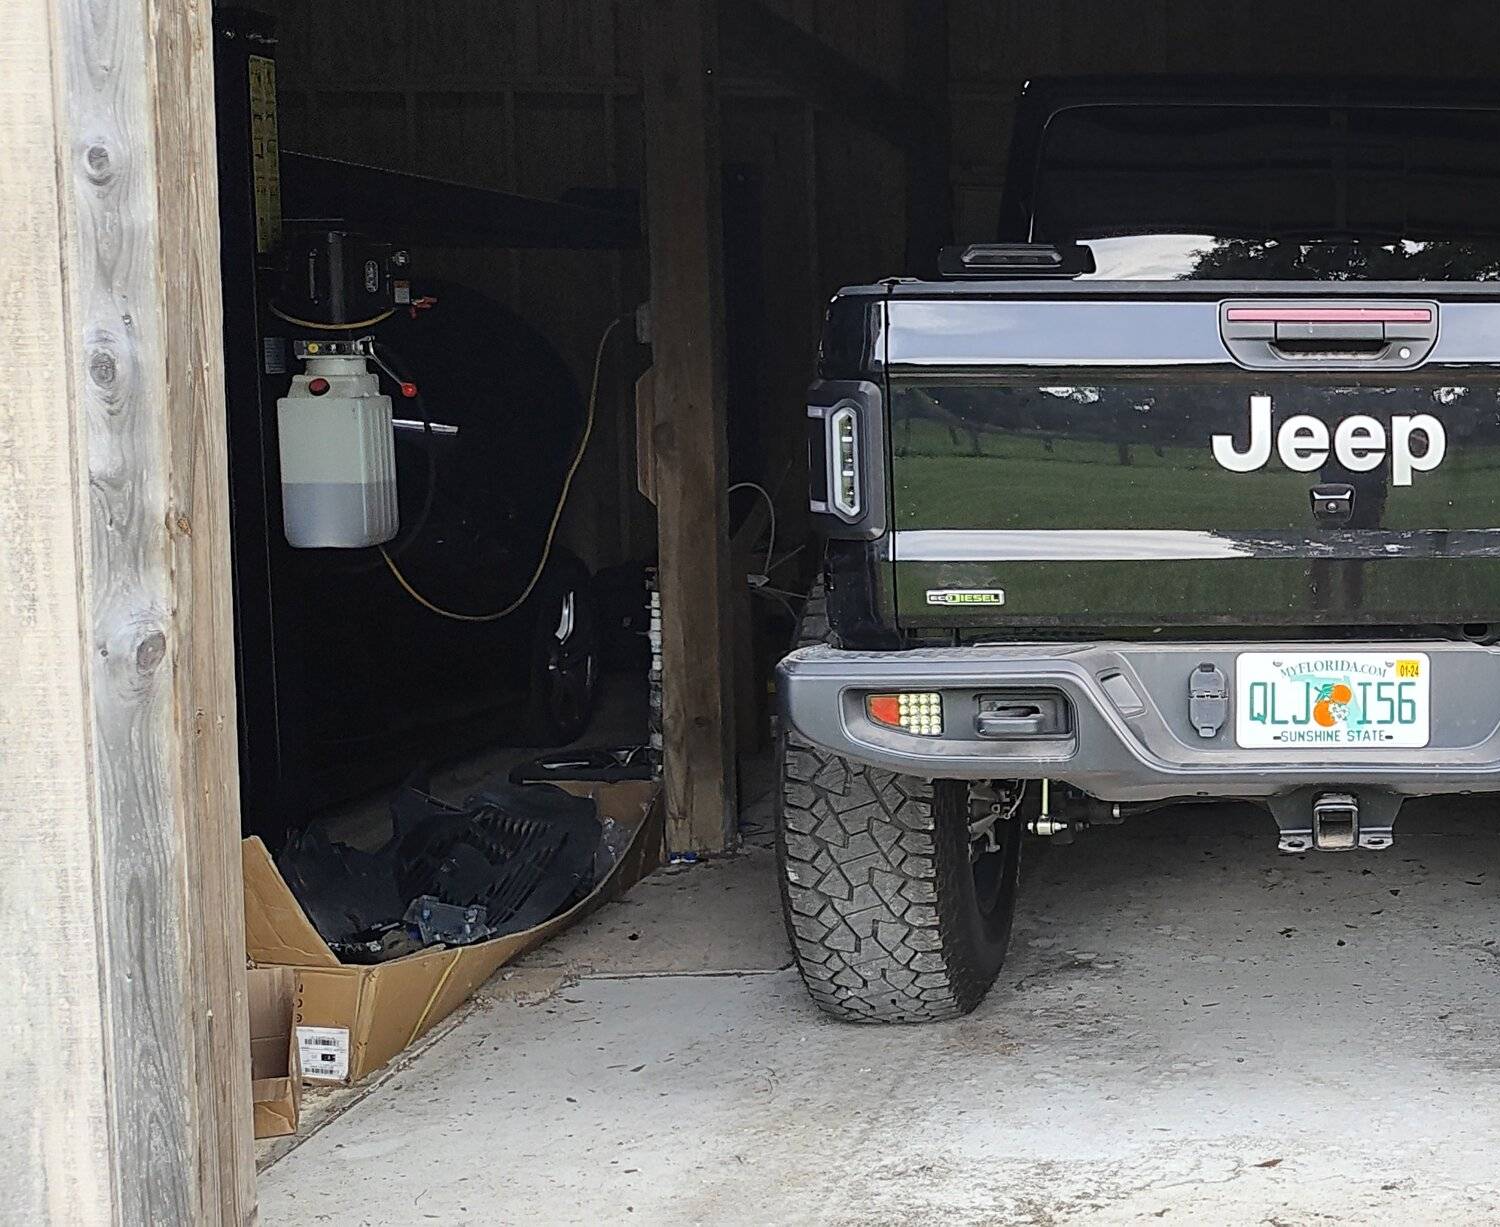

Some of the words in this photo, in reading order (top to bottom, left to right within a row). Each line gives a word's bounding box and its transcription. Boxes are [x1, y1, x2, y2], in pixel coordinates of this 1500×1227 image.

[1211, 394, 1447, 487] Jeep
[1248, 681, 1311, 726] QLJ
[1356, 681, 1417, 725] I56
[1280, 729, 1341, 743] SUNSHINE
[1346, 729, 1386, 742] STATE
